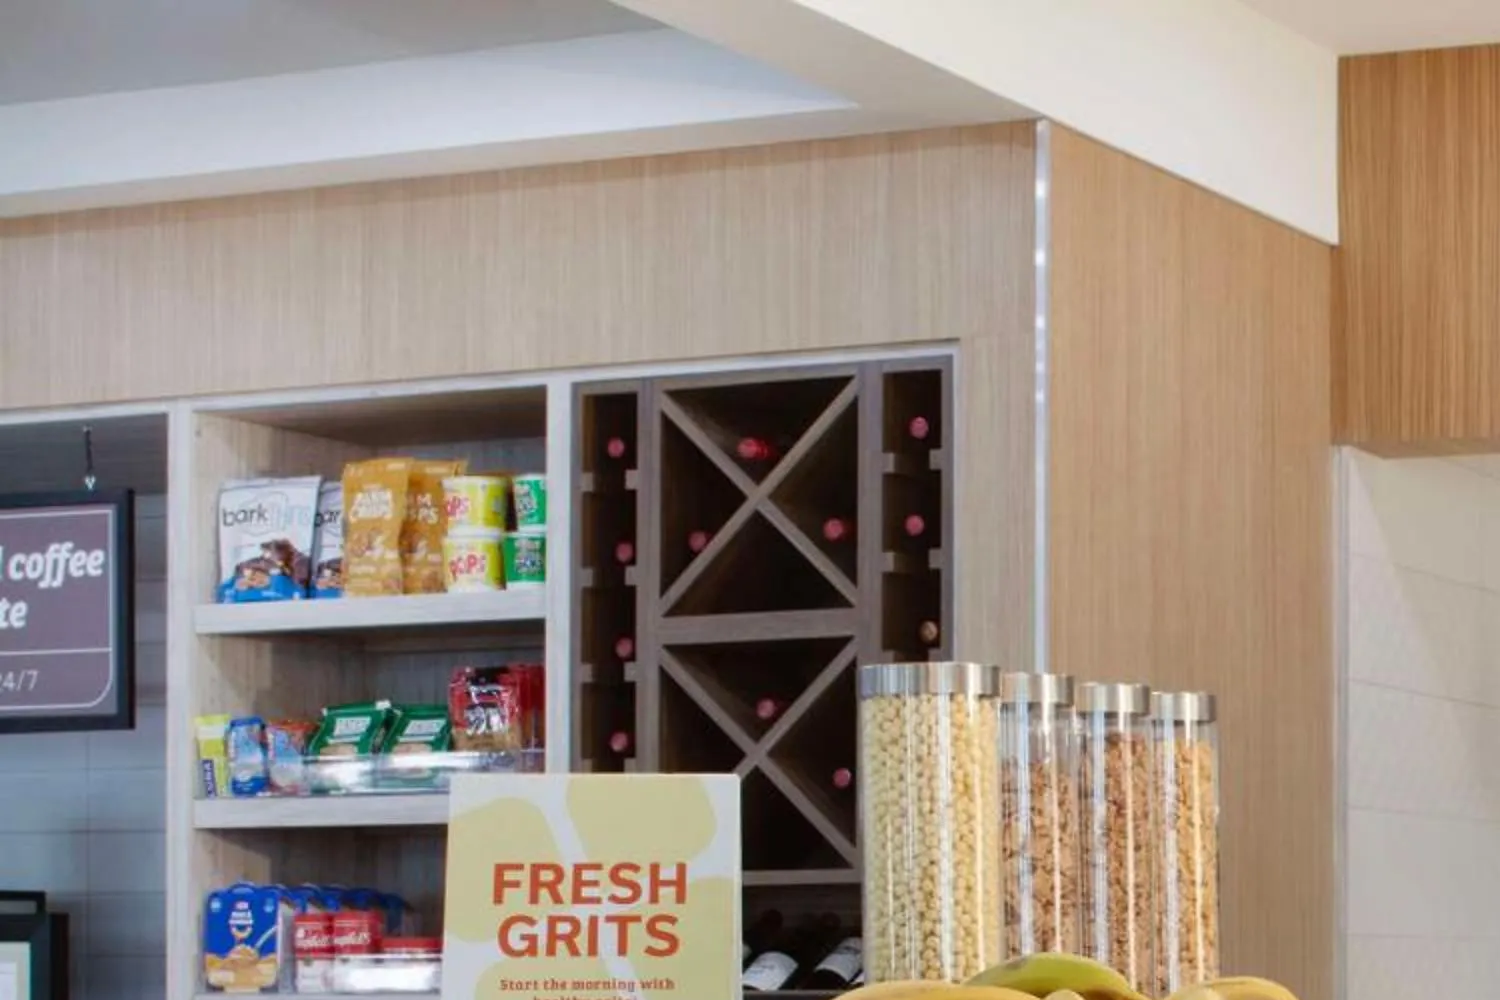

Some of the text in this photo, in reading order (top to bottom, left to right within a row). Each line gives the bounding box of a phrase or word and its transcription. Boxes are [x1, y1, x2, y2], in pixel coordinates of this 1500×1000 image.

[7, 541, 105, 589] coffee
[492, 861, 688, 906] FRESH
[496, 913, 681, 959] GRITS
[499, 976, 676, 993] Start the morning with
